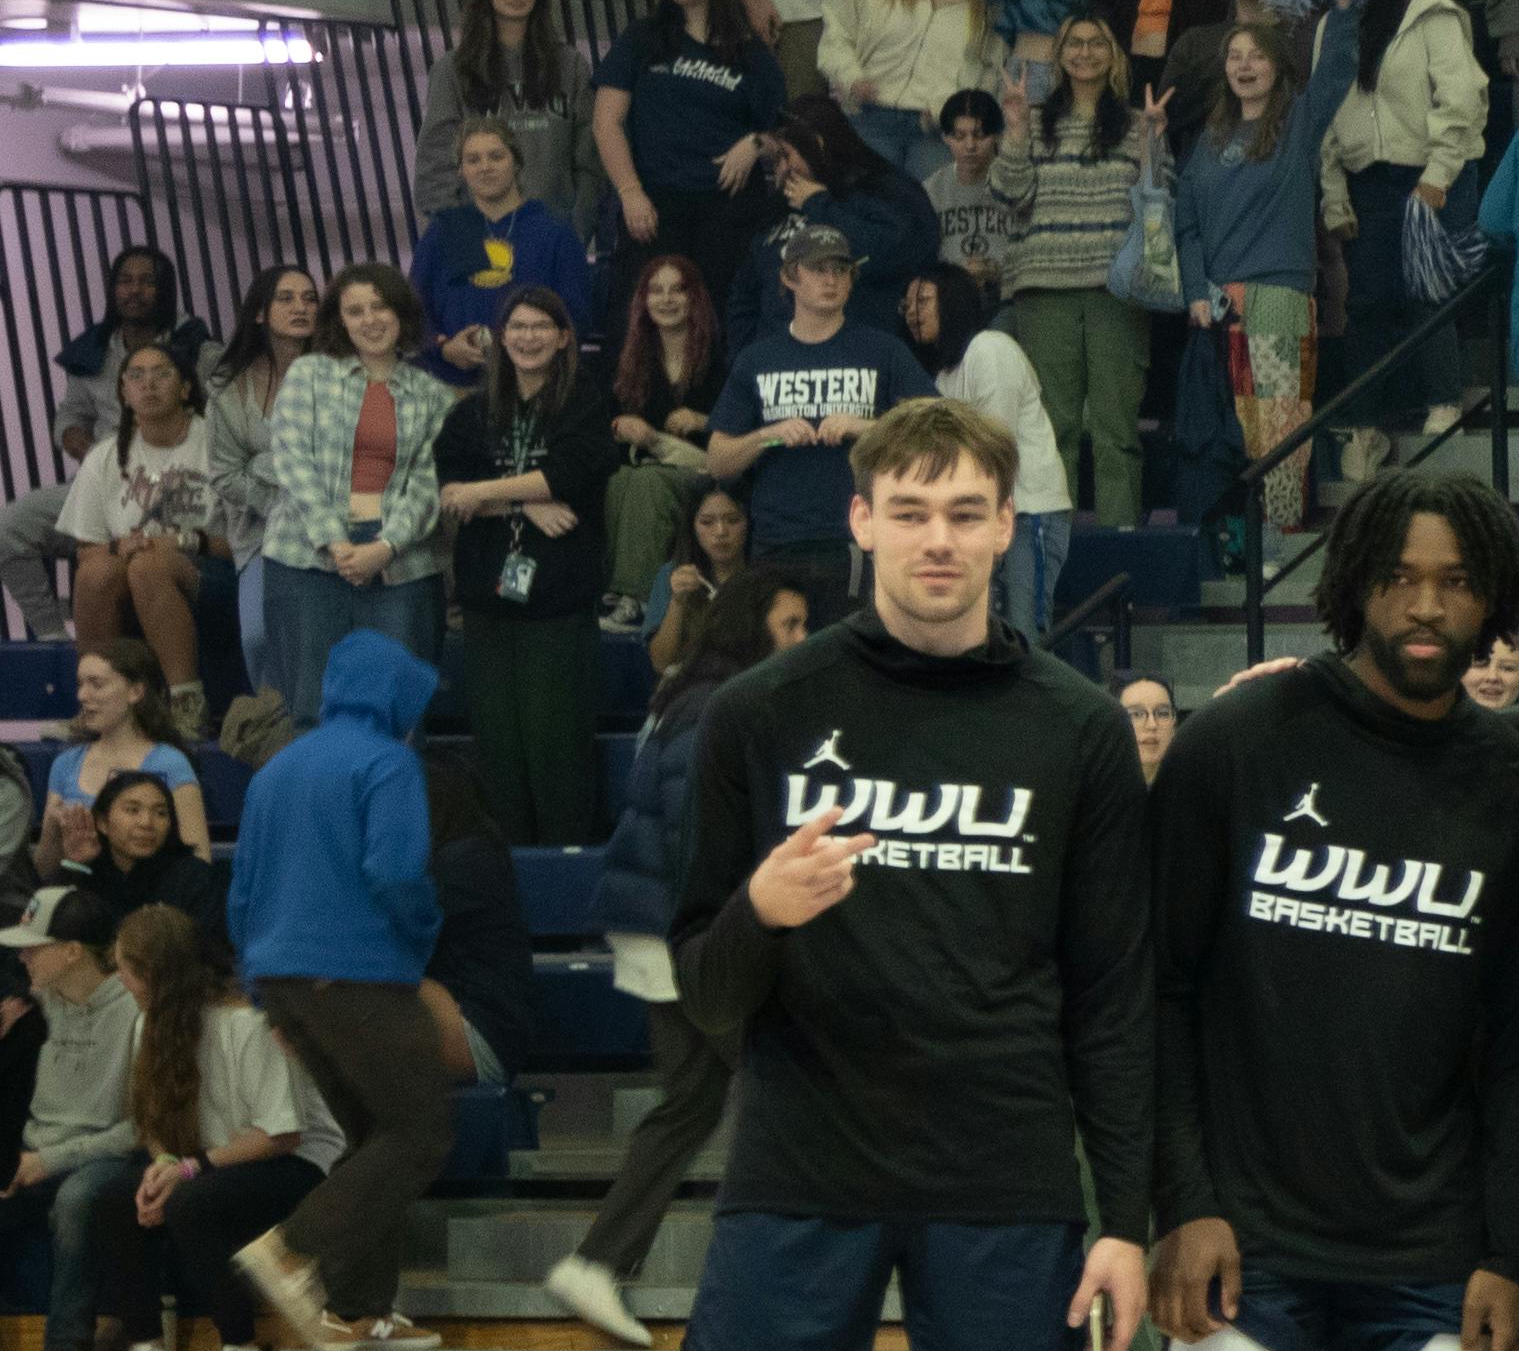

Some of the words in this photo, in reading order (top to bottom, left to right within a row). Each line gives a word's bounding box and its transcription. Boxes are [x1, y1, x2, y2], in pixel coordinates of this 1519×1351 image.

[757, 367, 878, 407] WESTERN
[786, 773, 1034, 841] WWU
[1253, 833, 1486, 918] WWU
[1249, 890, 1473, 955] BASKETBALL
